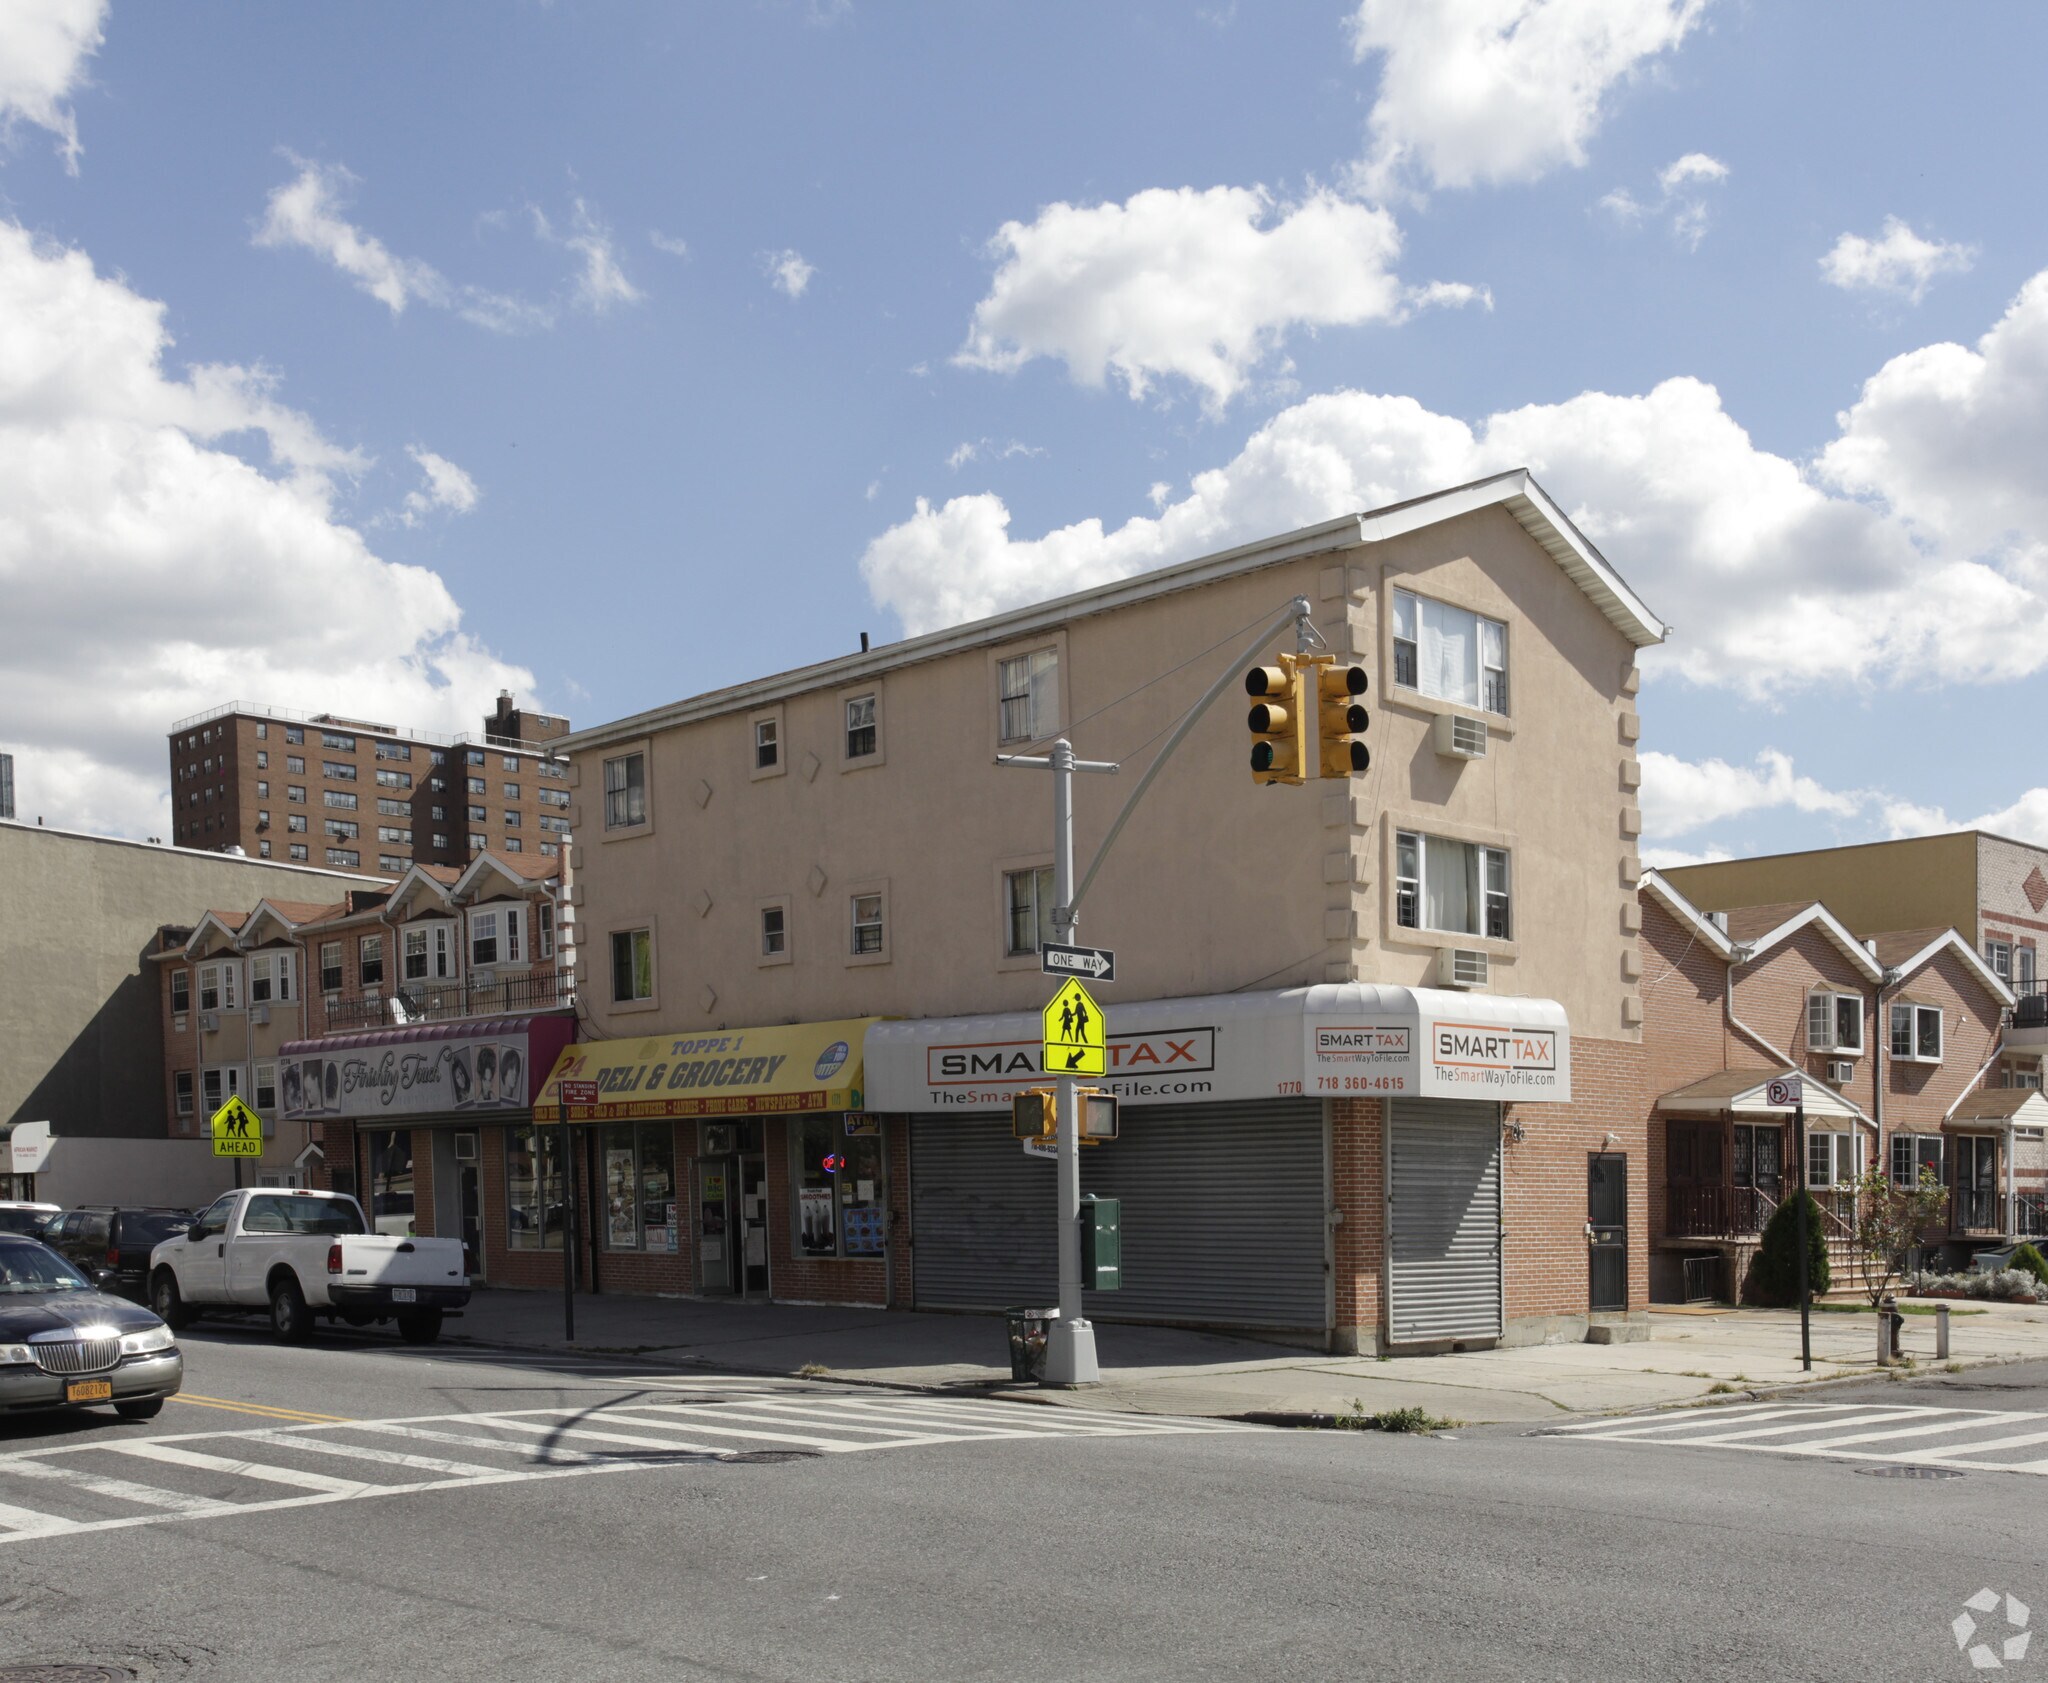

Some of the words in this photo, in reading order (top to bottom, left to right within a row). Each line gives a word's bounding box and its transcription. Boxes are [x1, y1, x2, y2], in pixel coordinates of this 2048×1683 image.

[1053, 953, 1074, 967] ONE
[1083, 957, 1104, 971] WAY
[671, 1037, 731, 1056] TOPPE
[1320, 1034, 1373, 1046] SMART
[1375, 1034, 1405, 1046] TAX
[1440, 1033, 1511, 1059] SMART
[1512, 1039, 1549, 1061] TAX
[1106, 1039, 1198, 1067] TAX
[1317, 1053, 1410, 1064] TheSmartWayToFile.com
[343, 1050, 399, 1106] Finishing
[401, 1045, 452, 1090] Touch
[555, 1055, 588, 1078] 24
[596, 1065, 647, 1093] DELI
[645, 1062, 668, 1090] &
[667, 1055, 787, 1090] GROCERY
[1317, 1076, 1339, 1090] 718
[1344, 1076, 1404, 1090] 360-4615
[1435, 1066, 1556, 1087] TheSmartWayToFile.com
[1278, 1080, 1302, 1095] 1770
[628, 1101, 667, 1116] SANDWICHES
[673, 1100, 699, 1114] CANDIES
[705, 1098, 726, 1113] PHONE
[727, 1097, 749, 1112] CARDS
[755, 1094, 800, 1111] NEWSPAPERS
[807, 1092, 824, 1108] ATM
[220, 1141, 256, 1153] AHEAD
[822, 1157, 846, 1169] OPN
